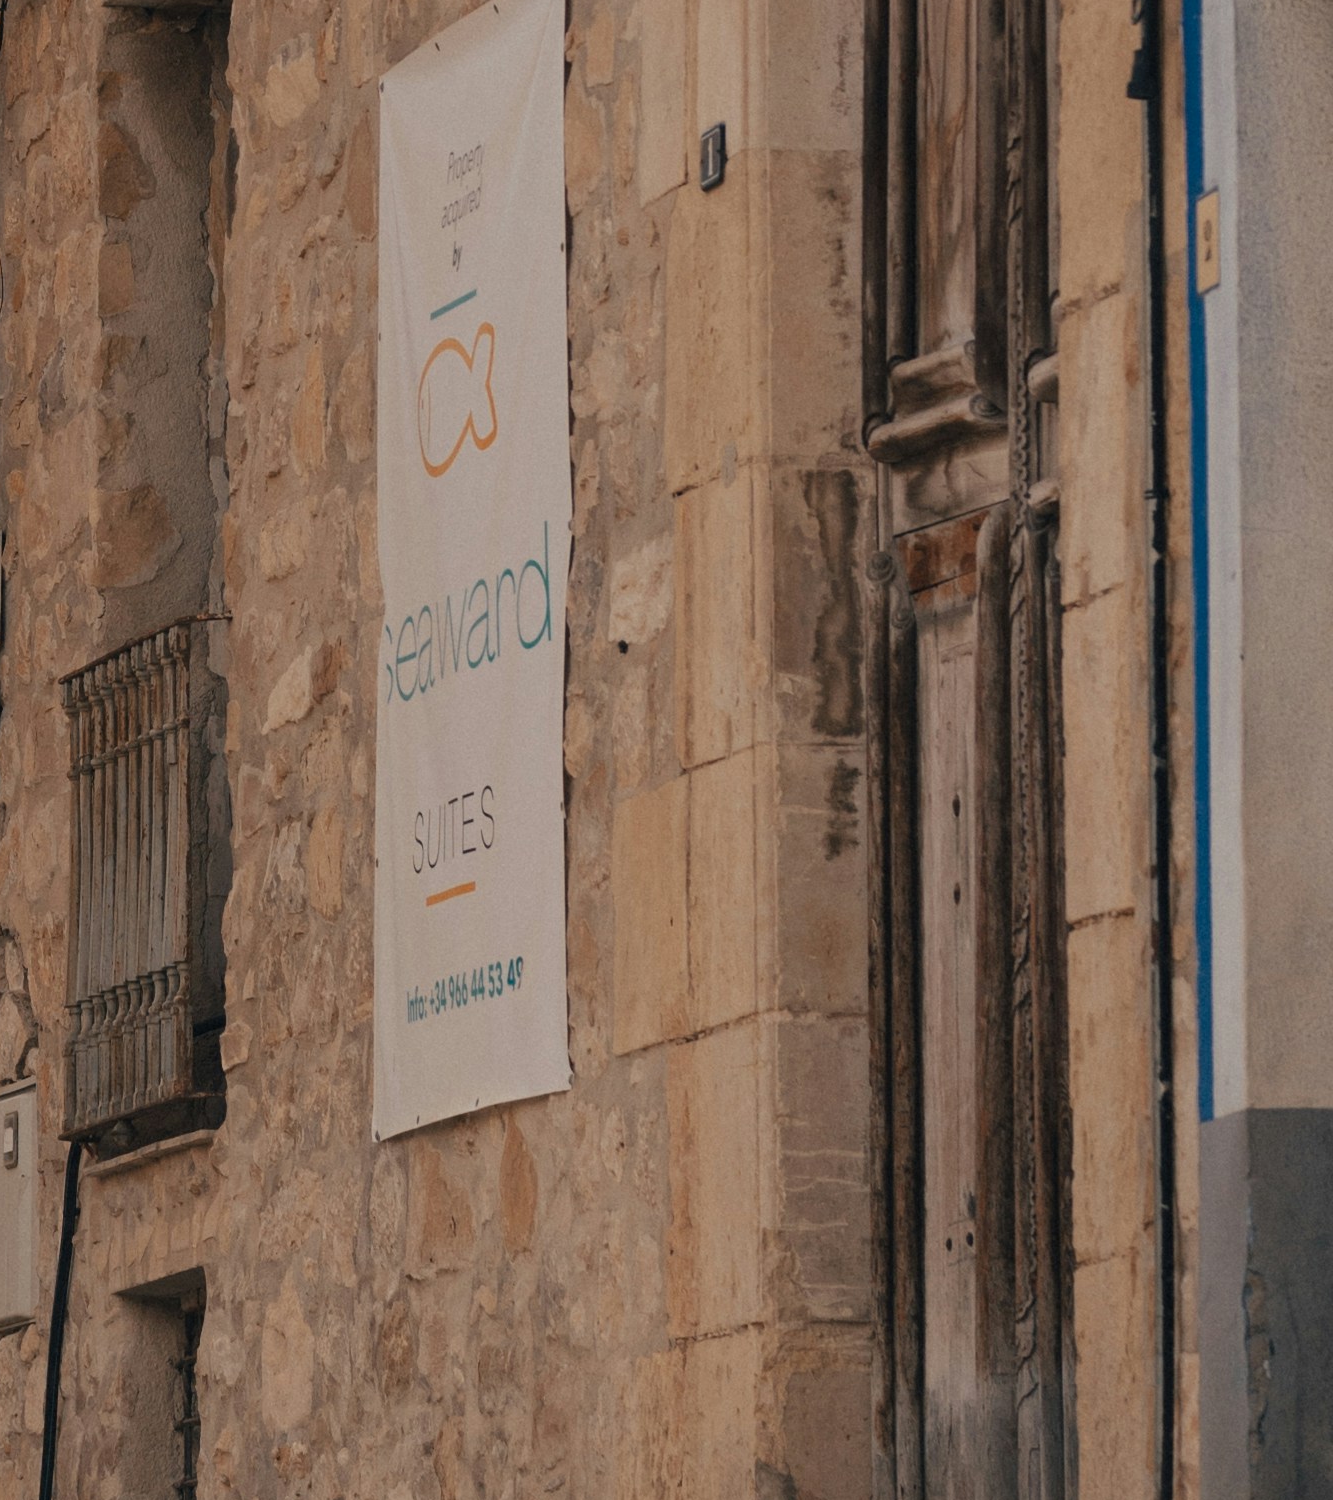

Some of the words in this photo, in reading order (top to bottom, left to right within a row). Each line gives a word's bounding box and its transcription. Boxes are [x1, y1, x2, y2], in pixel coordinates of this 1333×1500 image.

[447, 144, 483, 187] Property
[441, 183, 483, 231] acquired
[452, 241, 463, 272] by
[413, 785, 494, 874] SUITES
[406, 985, 428, 1024] Info:
[429, 978, 447, 1015] +34
[448, 971, 469, 1010] 966
[471, 966, 485, 1002] 44
[488, 960, 503, 998] 53
[507, 956, 524, 991] 49
